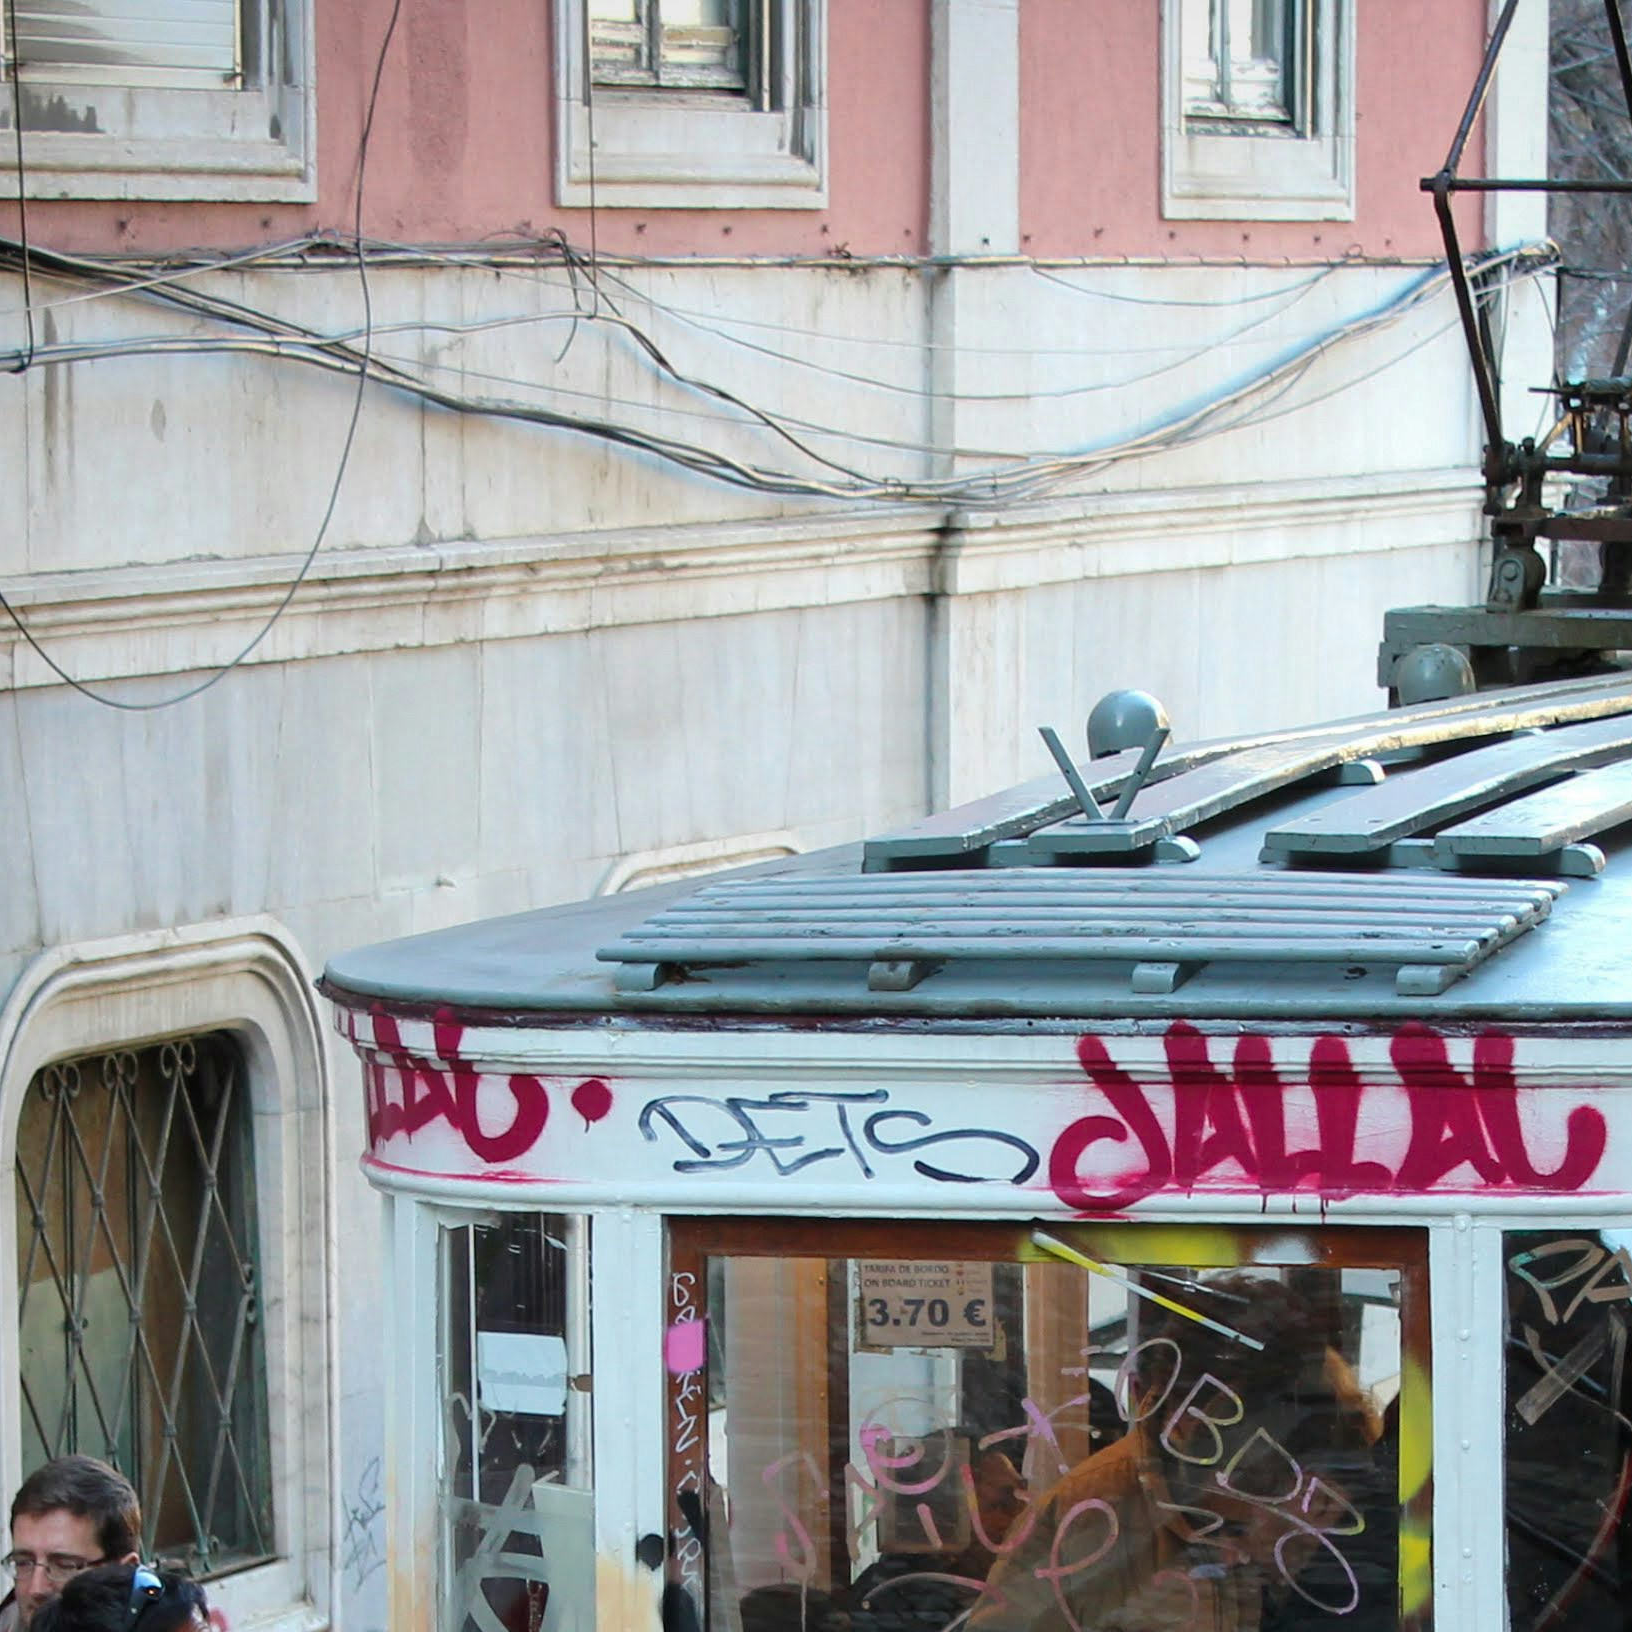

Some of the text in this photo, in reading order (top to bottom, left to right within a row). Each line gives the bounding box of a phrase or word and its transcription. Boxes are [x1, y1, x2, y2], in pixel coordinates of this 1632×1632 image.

[864, 1264, 949, 1274] TARIFA DE BORDO
[864, 1279, 950, 1288] ON BOARD TICKET
[868, 1298, 986, 1327] 3.70 €
